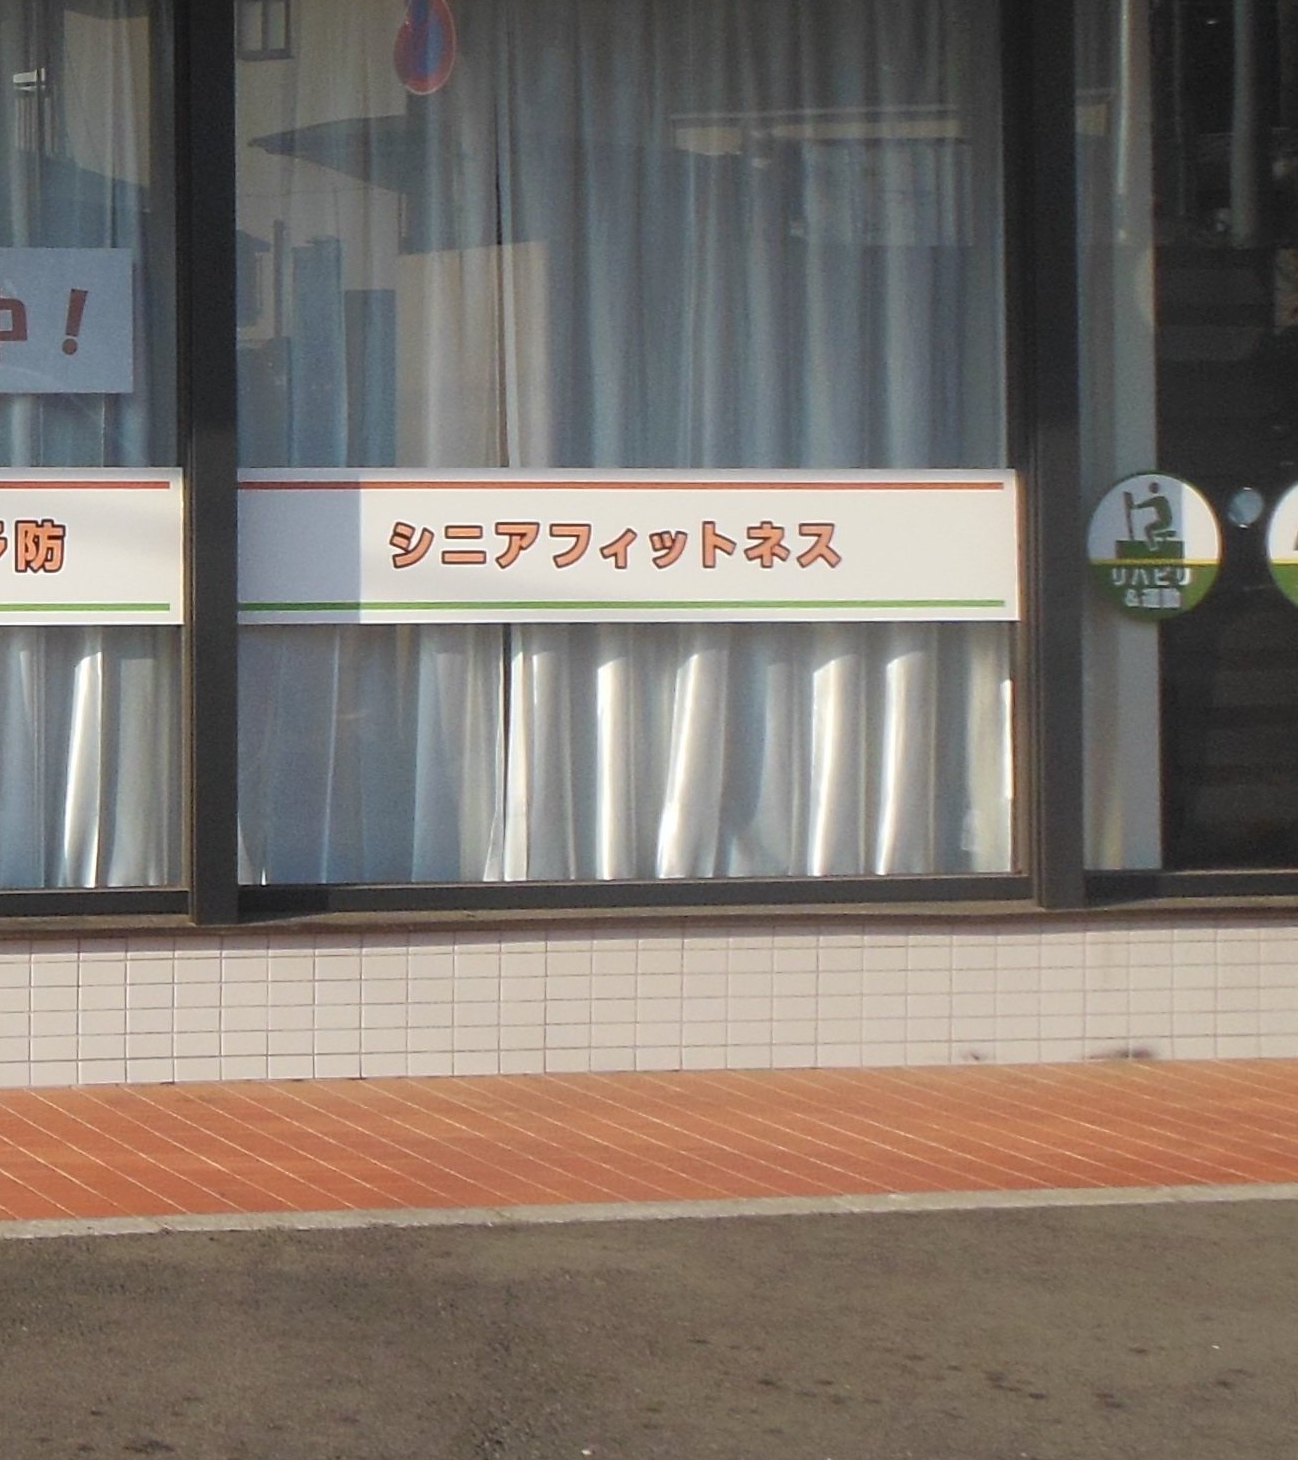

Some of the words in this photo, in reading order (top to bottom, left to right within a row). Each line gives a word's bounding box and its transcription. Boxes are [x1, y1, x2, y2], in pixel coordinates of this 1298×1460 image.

[387, 518, 845, 572] シニアフィットネス
